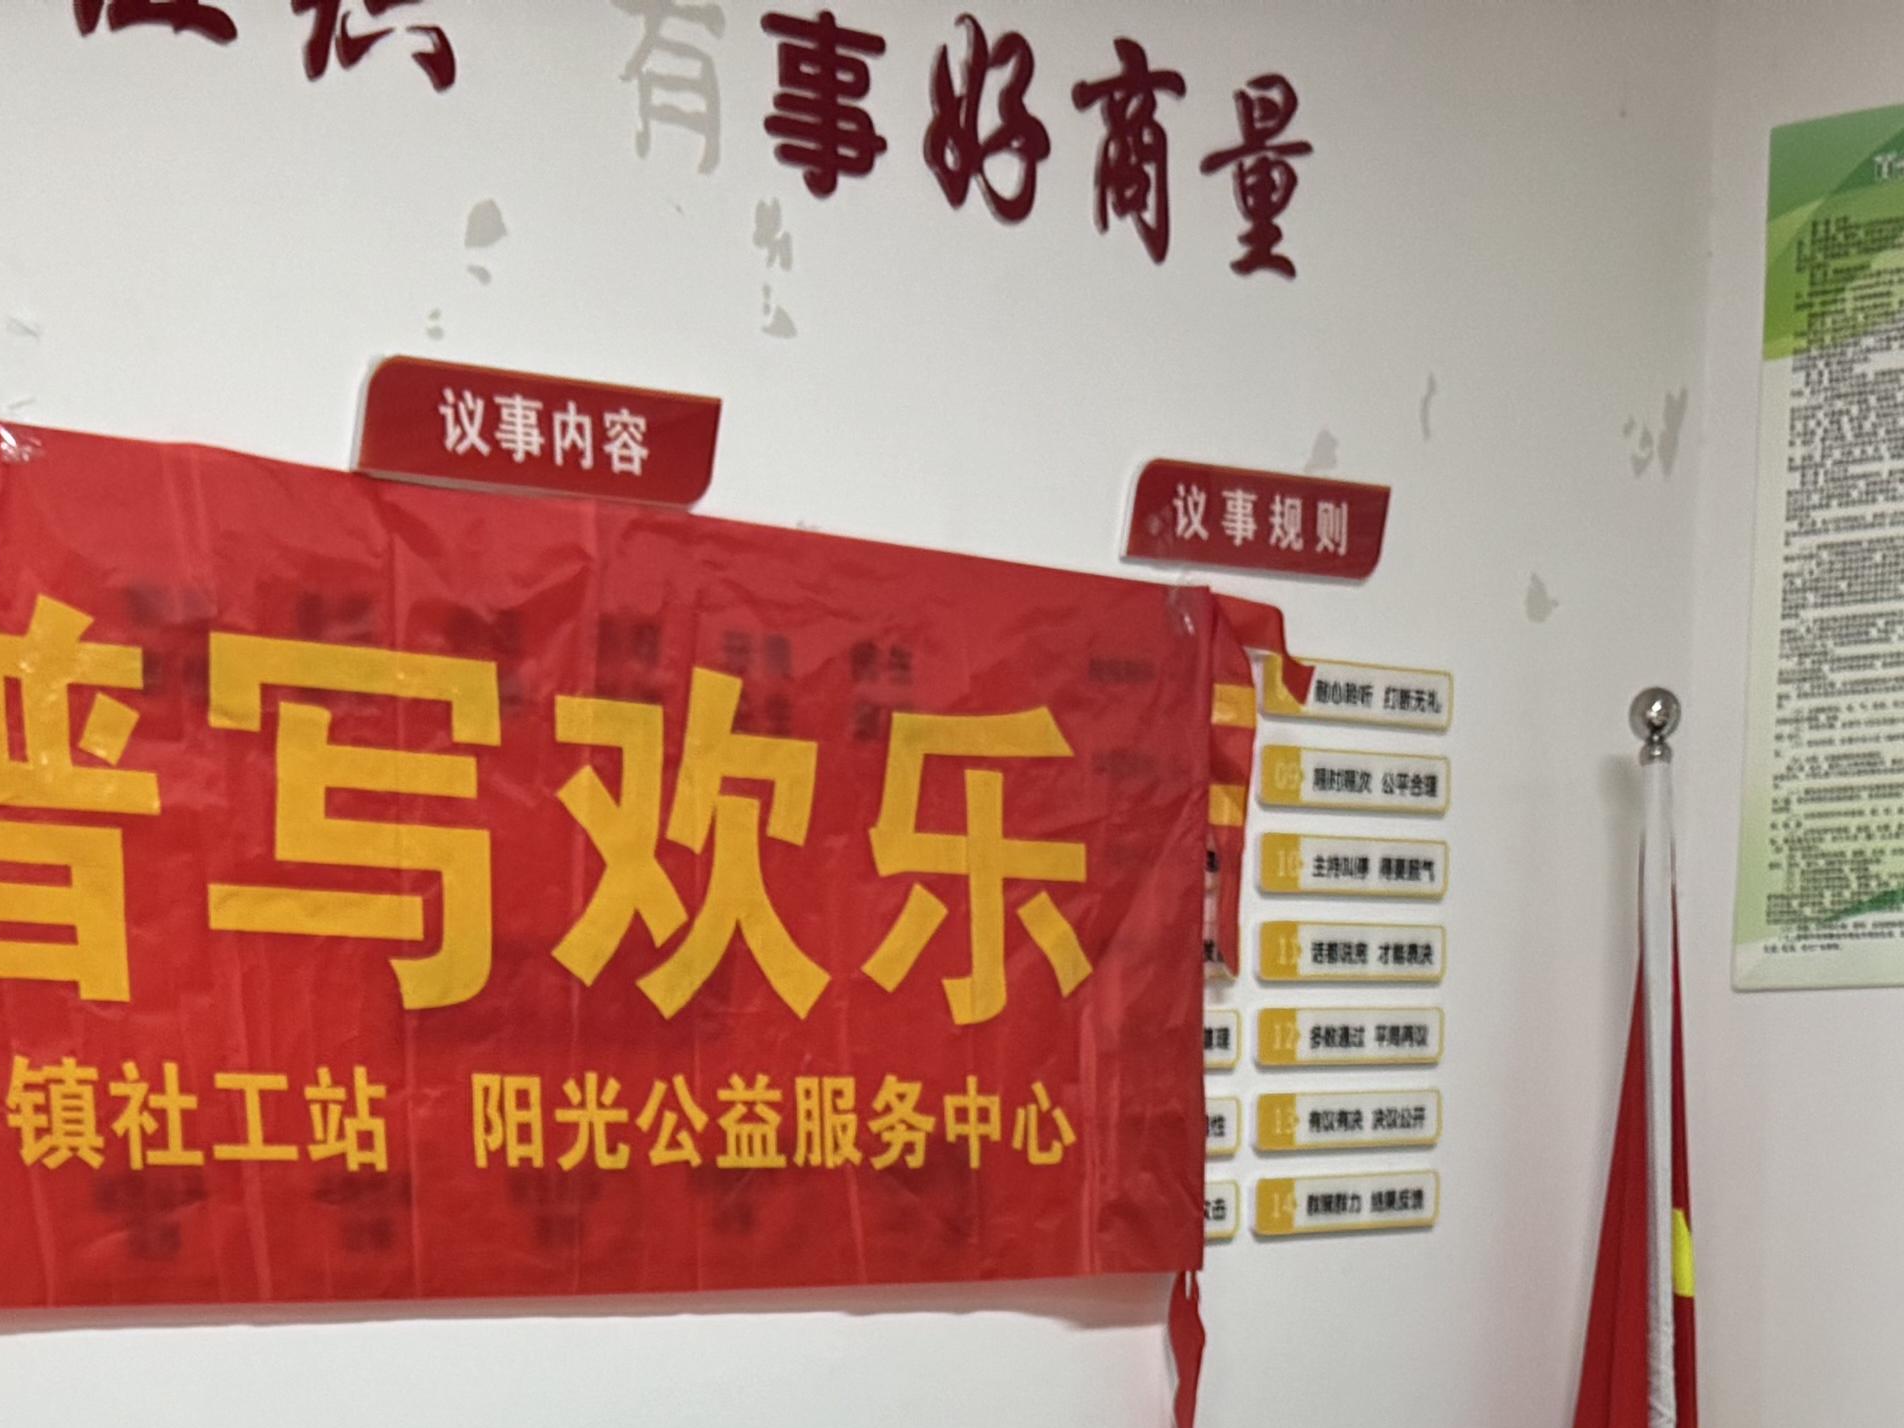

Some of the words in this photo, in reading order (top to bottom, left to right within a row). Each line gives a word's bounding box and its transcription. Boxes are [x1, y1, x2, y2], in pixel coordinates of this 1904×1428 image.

[438, 387, 650, 477] 议事内容
[1173, 483, 1348, 556] 议事规则
[472, 1072, 1076, 1170] 阳光公益服务中心
